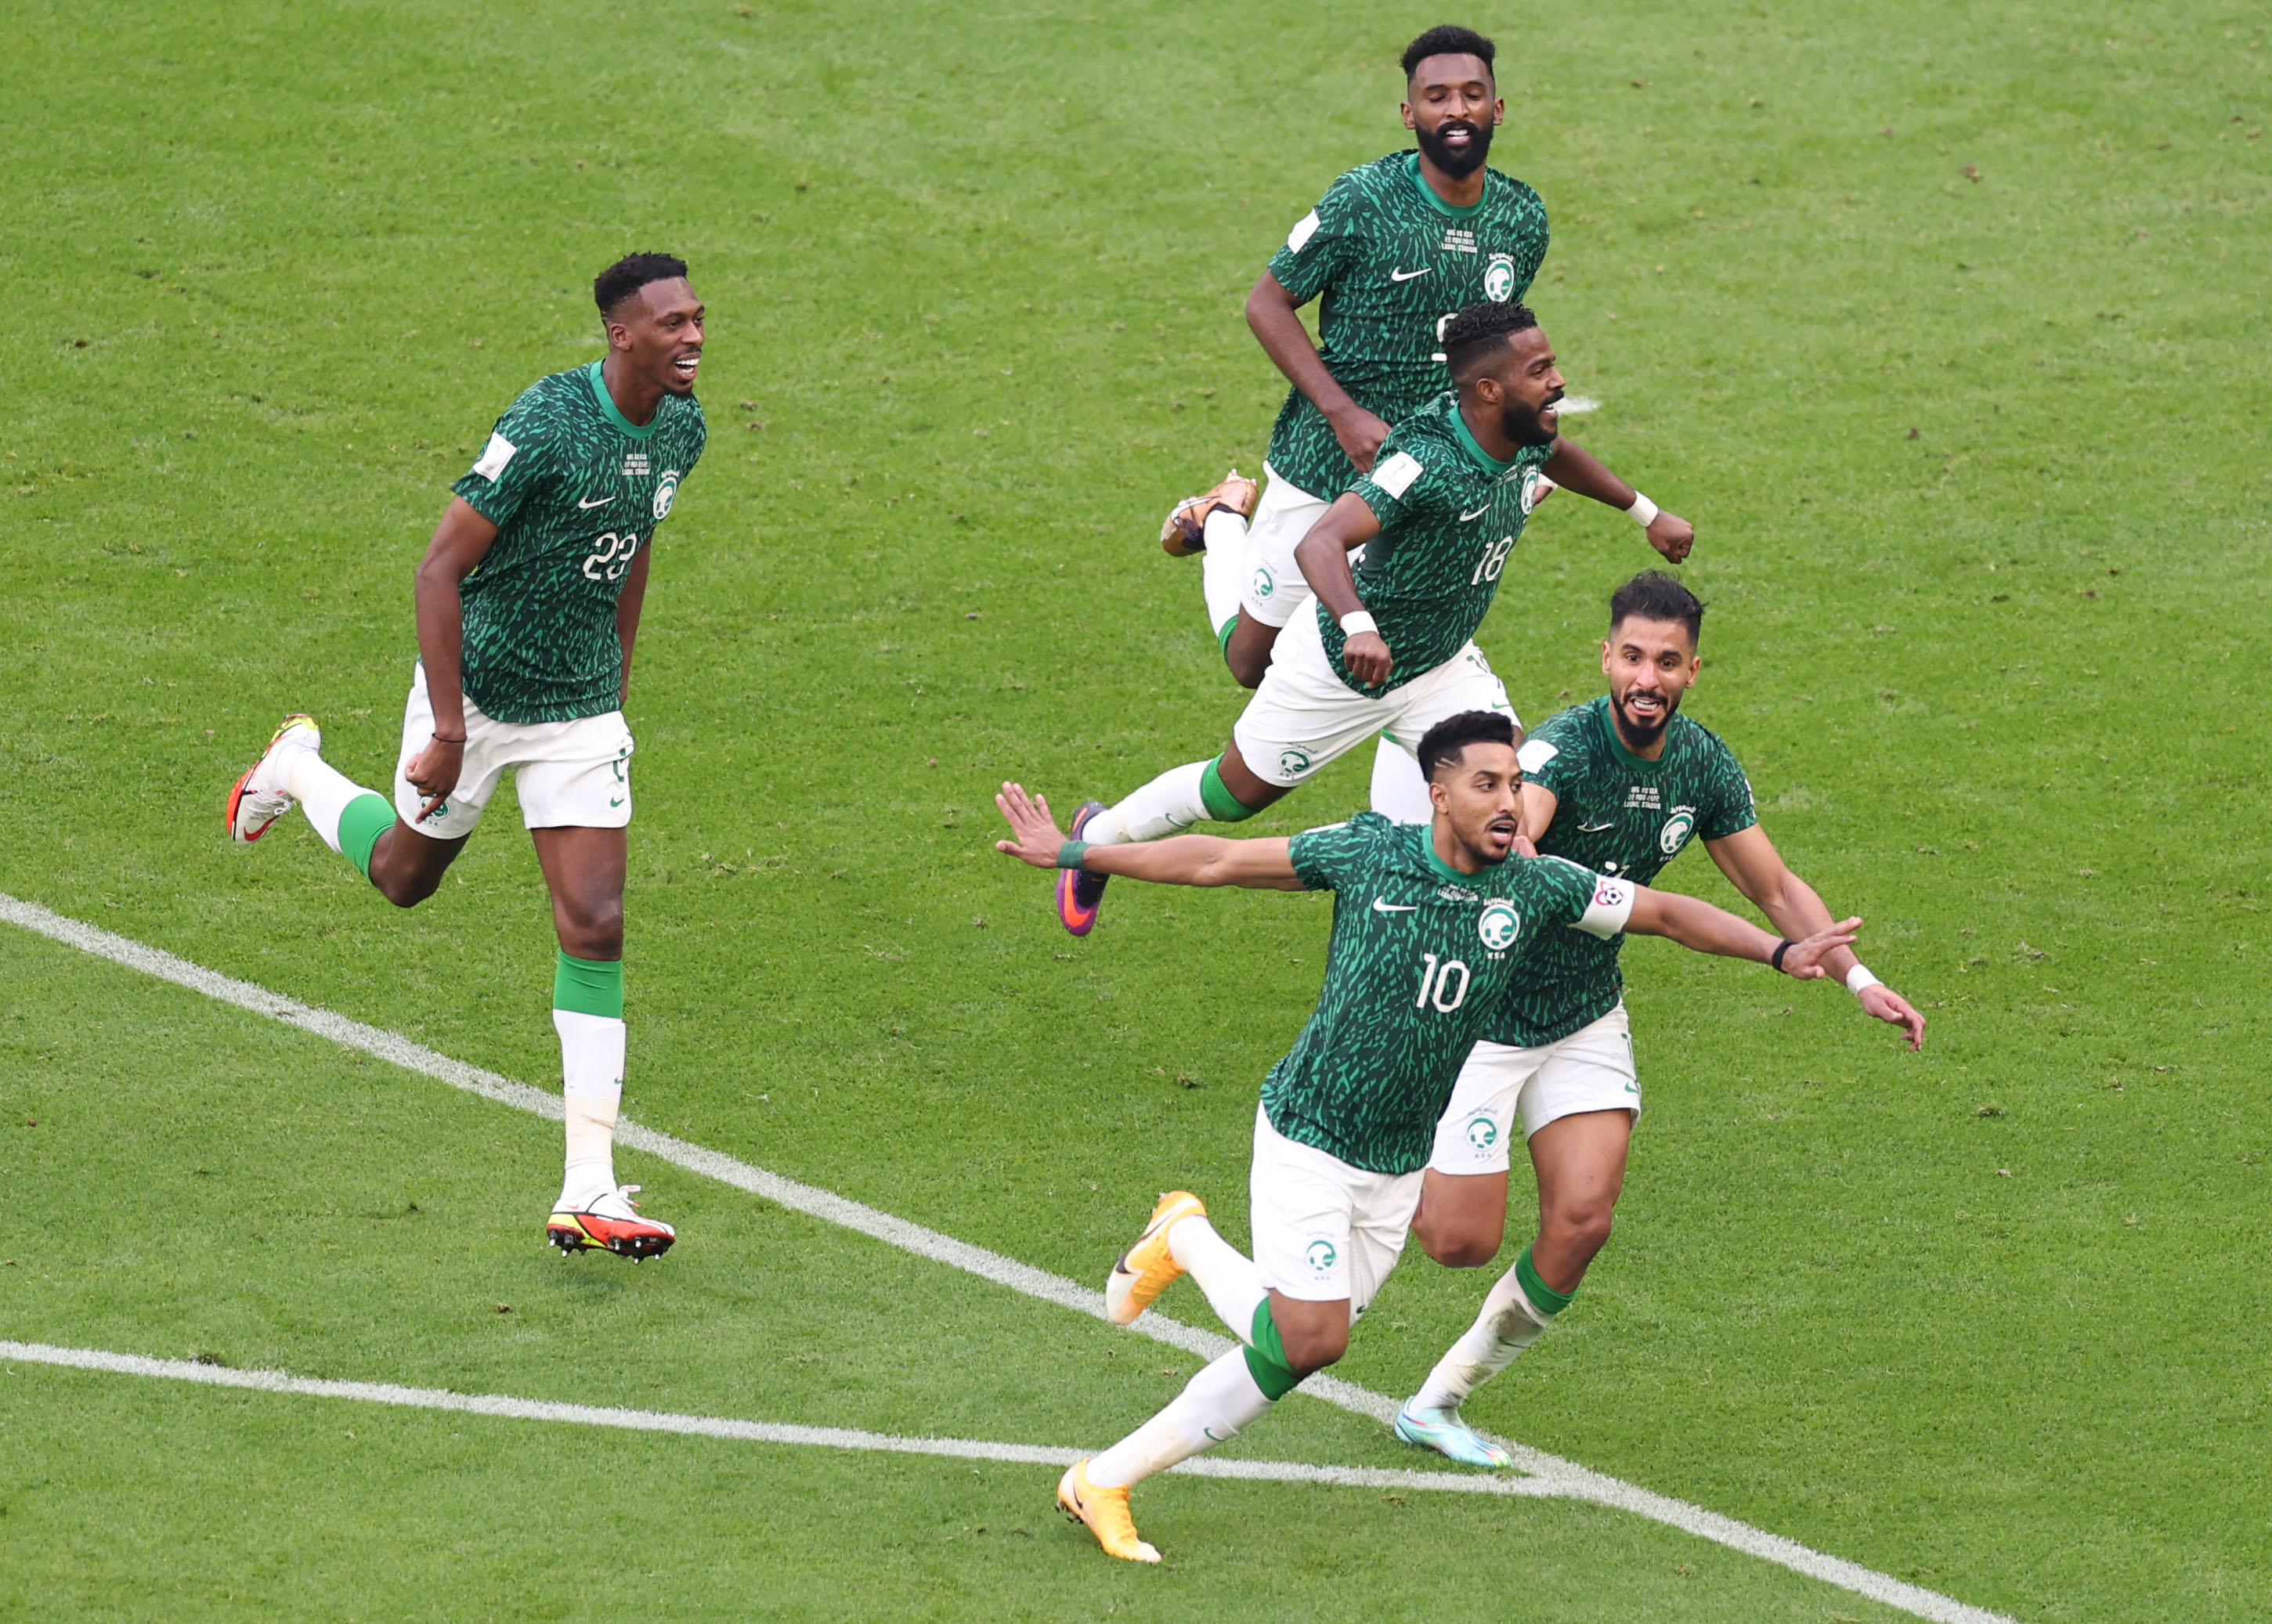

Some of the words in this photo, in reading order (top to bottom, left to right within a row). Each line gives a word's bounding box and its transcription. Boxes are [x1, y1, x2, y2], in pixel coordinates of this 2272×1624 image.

[583, 531, 638, 581] 23
[1471, 536, 1513, 586] 18
[1486, 951, 1506, 960] KSA
[1416, 952, 1471, 1013] 10
